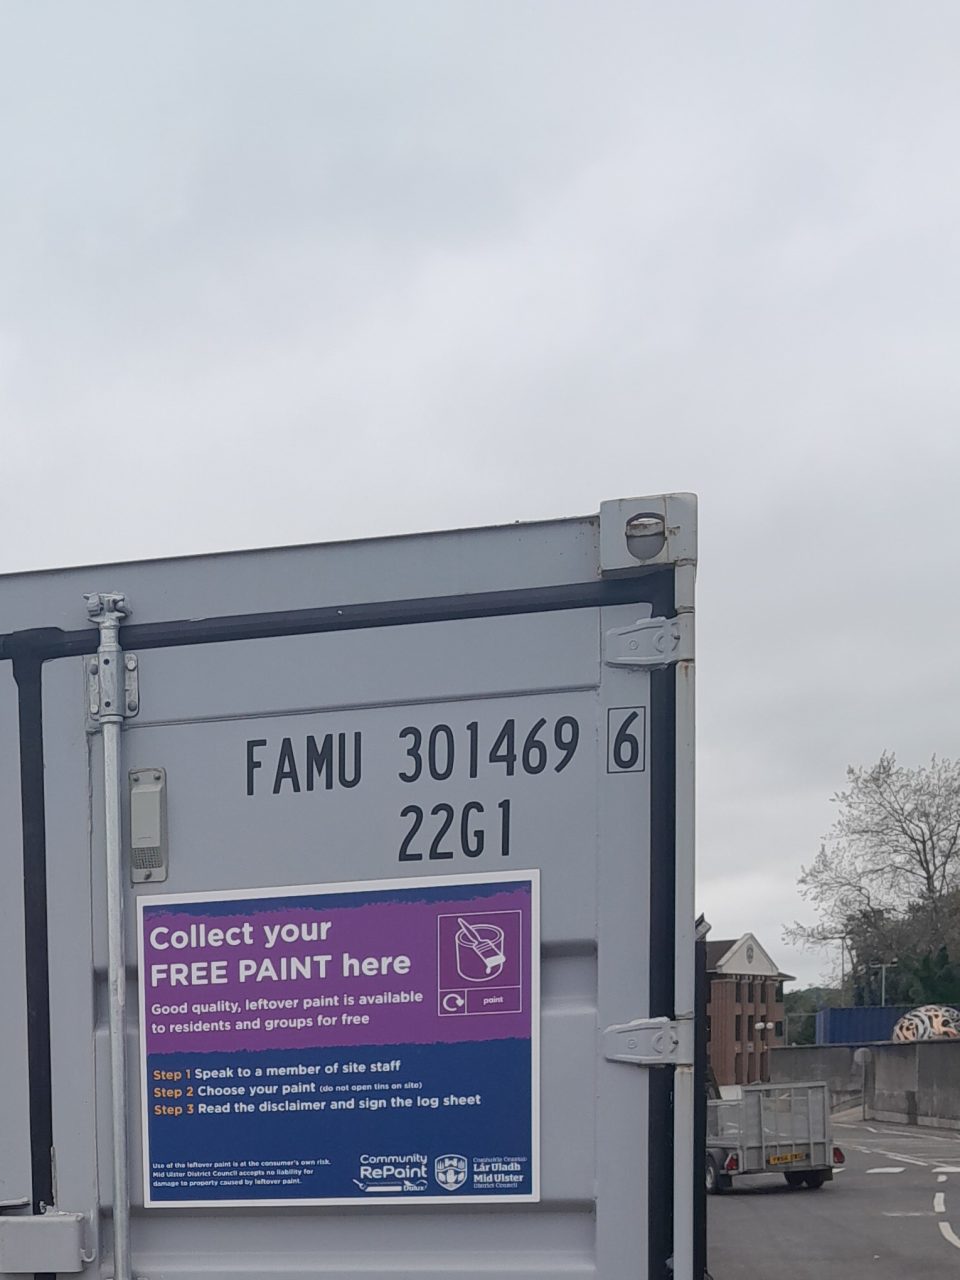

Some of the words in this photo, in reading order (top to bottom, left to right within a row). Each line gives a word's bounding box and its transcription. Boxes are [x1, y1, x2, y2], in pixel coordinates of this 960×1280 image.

[246, 731, 361, 796] FAMU
[398, 715, 580, 783] 301469
[613, 710, 640, 769] 6
[398, 799, 510, 862] 22G1
[150, 923, 253, 950] Collect
[263, 921, 332, 948] your
[151, 961, 228, 987] FREE
[239, 955, 332, 982] PAINT
[342, 952, 411, 977] here
[151, 1002, 187, 1015] Good
[191, 1000, 241, 1015] quality,
[245, 998, 298, 1010] leftover
[303, 994, 339, 1009] paint
[344, 994, 354, 1005] is
[359, 991, 423, 1005] available
[483, 996, 503, 1005] paint
[151, 1023, 165, 1033] to
[169, 1020, 231, 1033] residents
[235, 1018, 260, 1030] and
[264, 1016, 313, 1031] groups
[317, 1014, 337, 1026] for
[342, 1014, 369, 1025] free
[153, 1070, 182, 1081] Step
[186, 1070, 191, 1079] 1
[194, 1067, 234, 1081] Speak
[237, 1067, 251, 1077] to
[255, 1068, 263, 1077] a
[266, 1064, 321, 1076] member
[325, 1063, 338, 1074] of
[342, 1062, 366, 1073] site
[370, 1060, 401, 1072] staff
[153, 1087, 182, 1098] Step
[186, 1087, 193, 1096] 2
[198, 1086, 245, 1096] Choose
[249, 1085, 278, 1096] your
[282, 1082, 315, 1095] paint
[154, 1105, 182, 1116] Step
[187, 1104, 194, 1114] 3
[198, 1103, 230, 1113] Read
[234, 1102, 254, 1112] the
[259, 1099, 326, 1112] disclaimer
[330, 1098, 354, 1109] and
[359, 1097, 386, 1110] sign
[390, 1096, 412, 1107] the
[417, 1096, 438, 1108] log
[443, 1094, 481, 1105] sheet
[360, 1154, 427, 1164] Community
[360, 1166, 427, 1179] RePaint
[474, 1174, 492, 1182] Mid
[494, 1174, 523, 1182] Ulster
